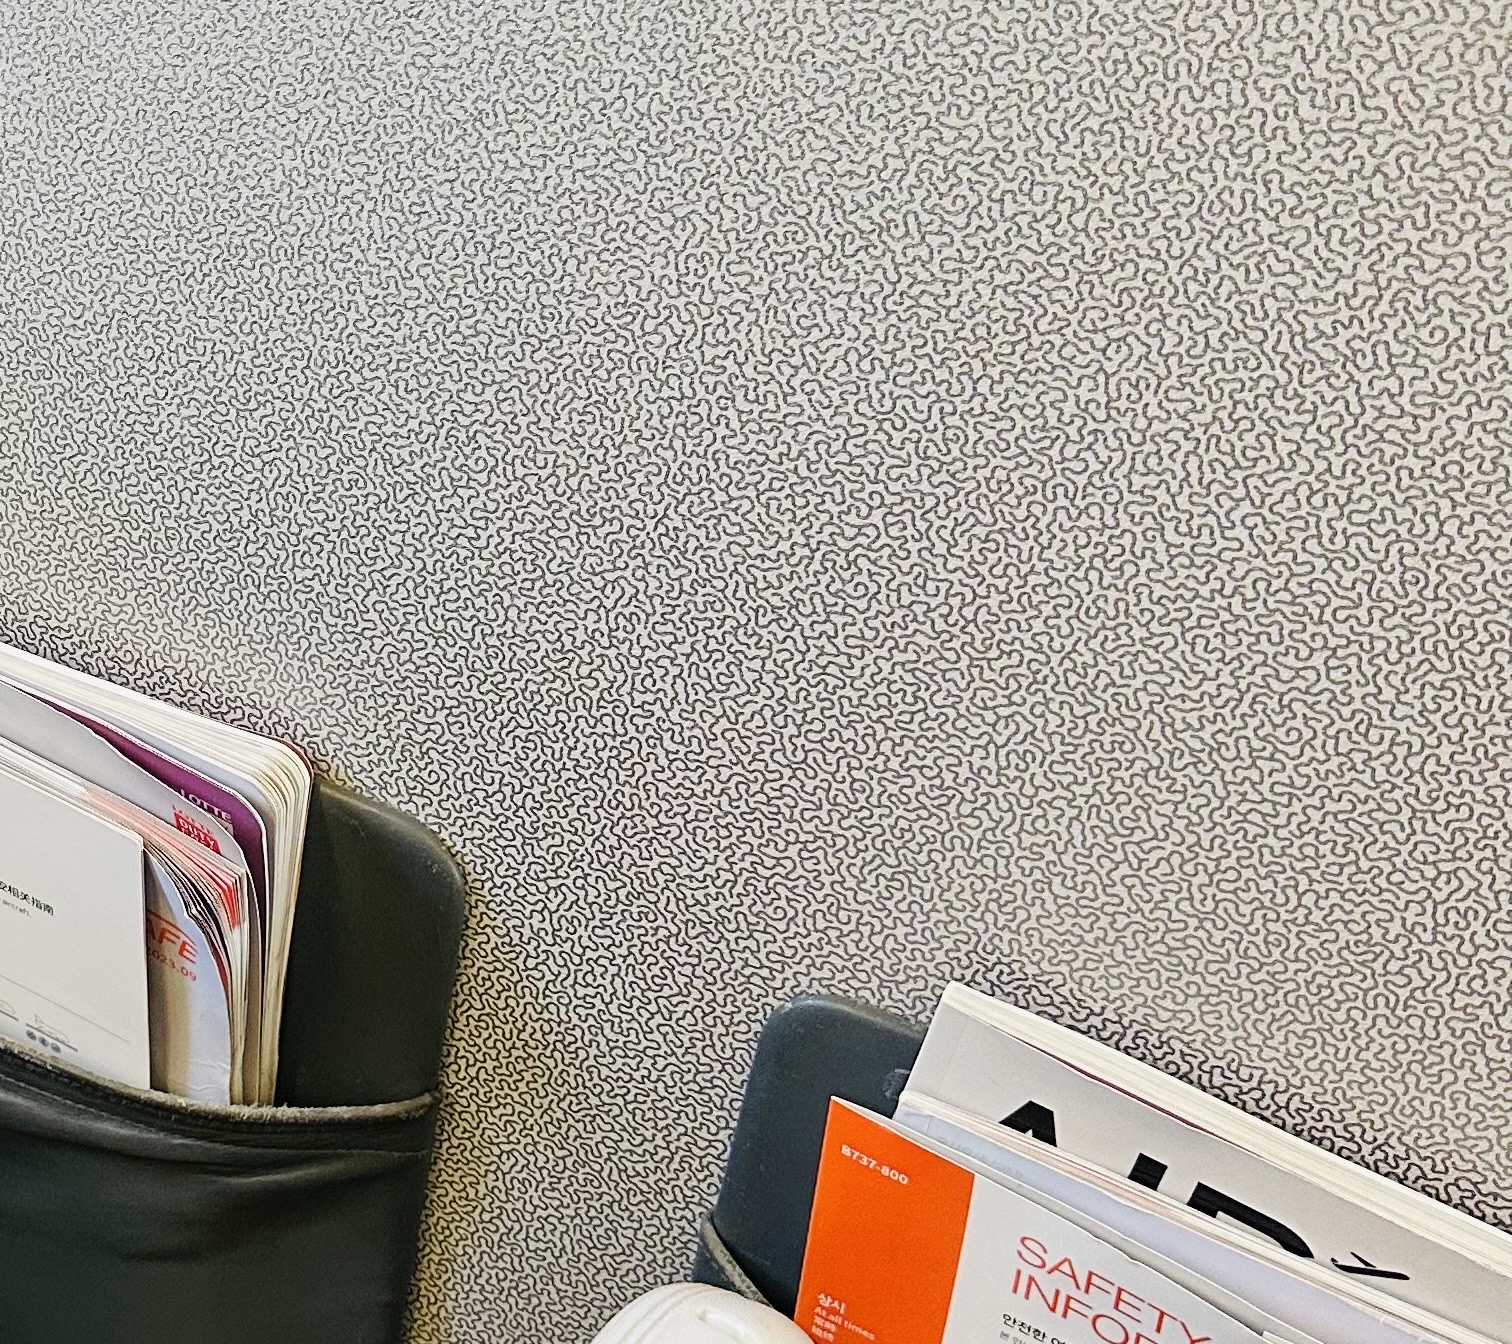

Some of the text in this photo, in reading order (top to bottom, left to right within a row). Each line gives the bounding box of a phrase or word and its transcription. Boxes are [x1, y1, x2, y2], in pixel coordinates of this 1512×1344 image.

[840, 1144, 909, 1185] B737-800
[843, 1319, 875, 1341] times
[1002, 1313, 1048, 1343] 안전한
